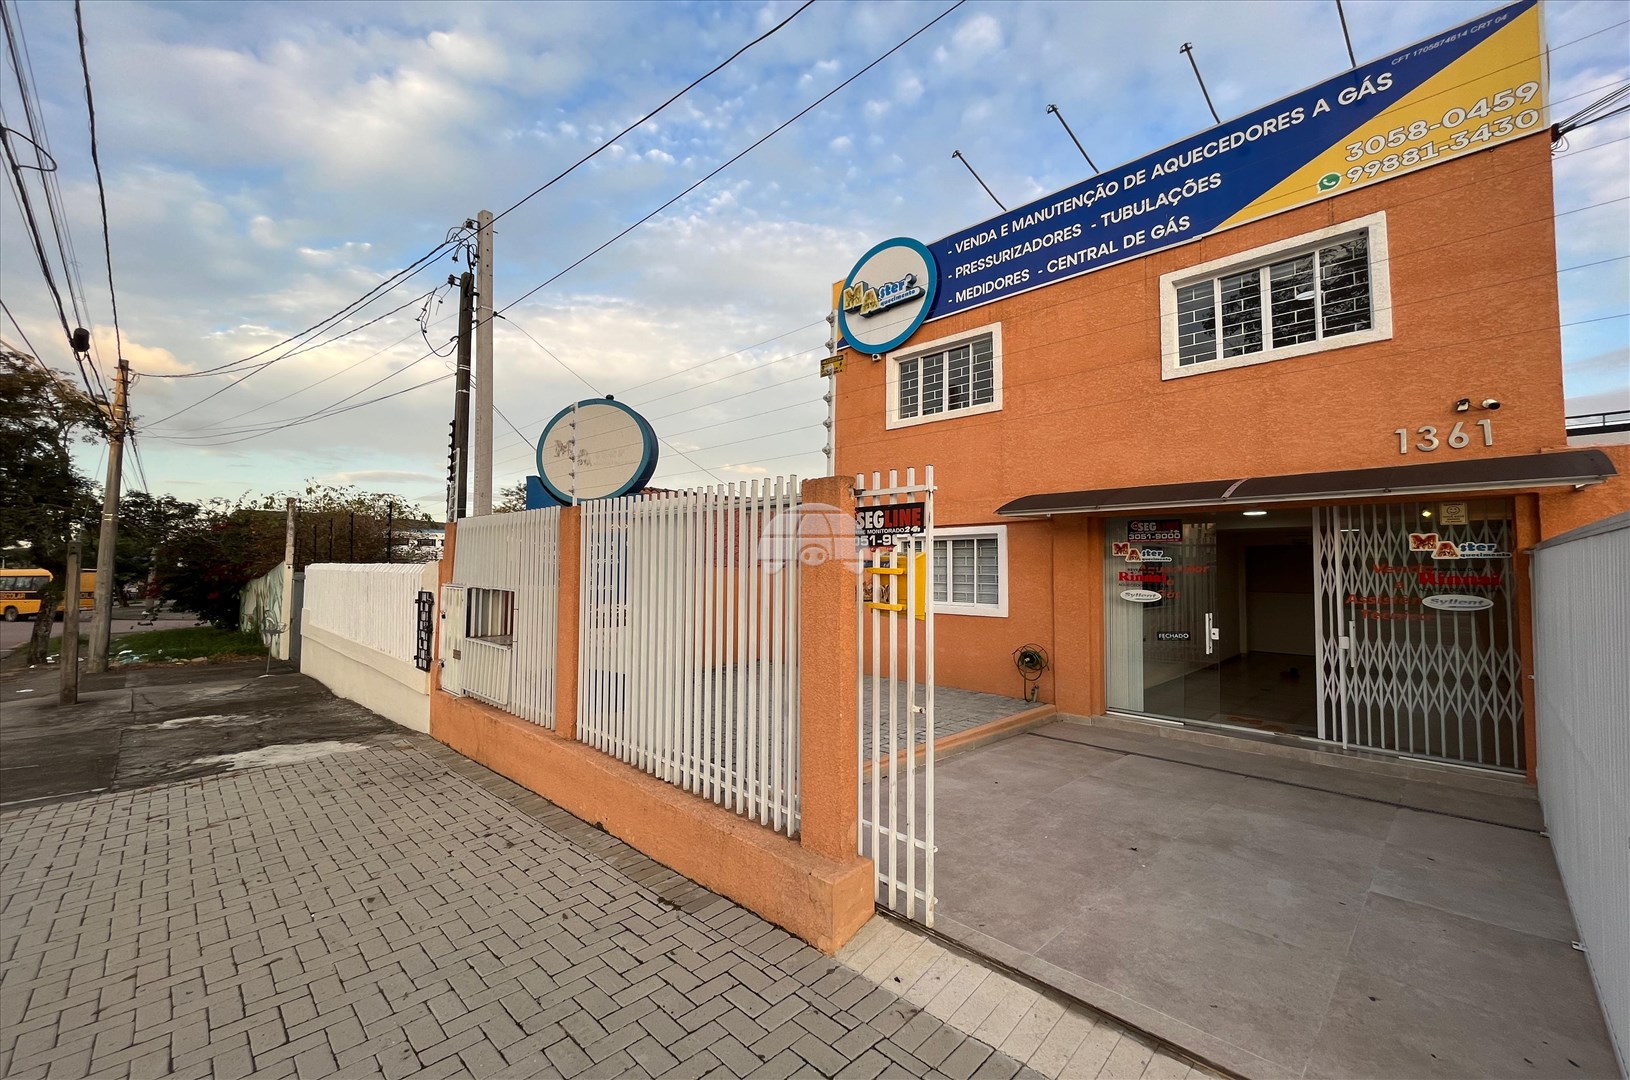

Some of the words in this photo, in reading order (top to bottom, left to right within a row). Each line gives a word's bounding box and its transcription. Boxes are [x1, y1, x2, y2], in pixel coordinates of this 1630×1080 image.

[1391, 53, 1410, 66] CFT
[1470, 19, 1493, 34] CRT
[1494, 13, 1508, 24] 04
[1345, 81, 1539, 162] 3058-0459
[1346, 109, 1540, 185] 99881-3430
[955, 229, 998, 254] VENDA
[1001, 224, 1009, 237] E
[1012, 181, 1119, 233] MANUTENÇÃO
[1123, 169, 1146, 191] DE
[1151, 107, 1305, 180] AQUECEDORES
[1312, 98, 1331, 118] A
[1337, 72, 1393, 106] GÁS
[955, 223, 1082, 279] PRESSURIZADORES
[1100, 172, 1221, 227] TUBULAÇÕES
[955, 269, 1030, 304] MEDIDORES
[1046, 240, 1119, 273] CENTRAL
[1123, 230, 1146, 249] DE
[1150, 215, 1191, 240] GÁS
[1394, 418, 1493, 454] 1361
